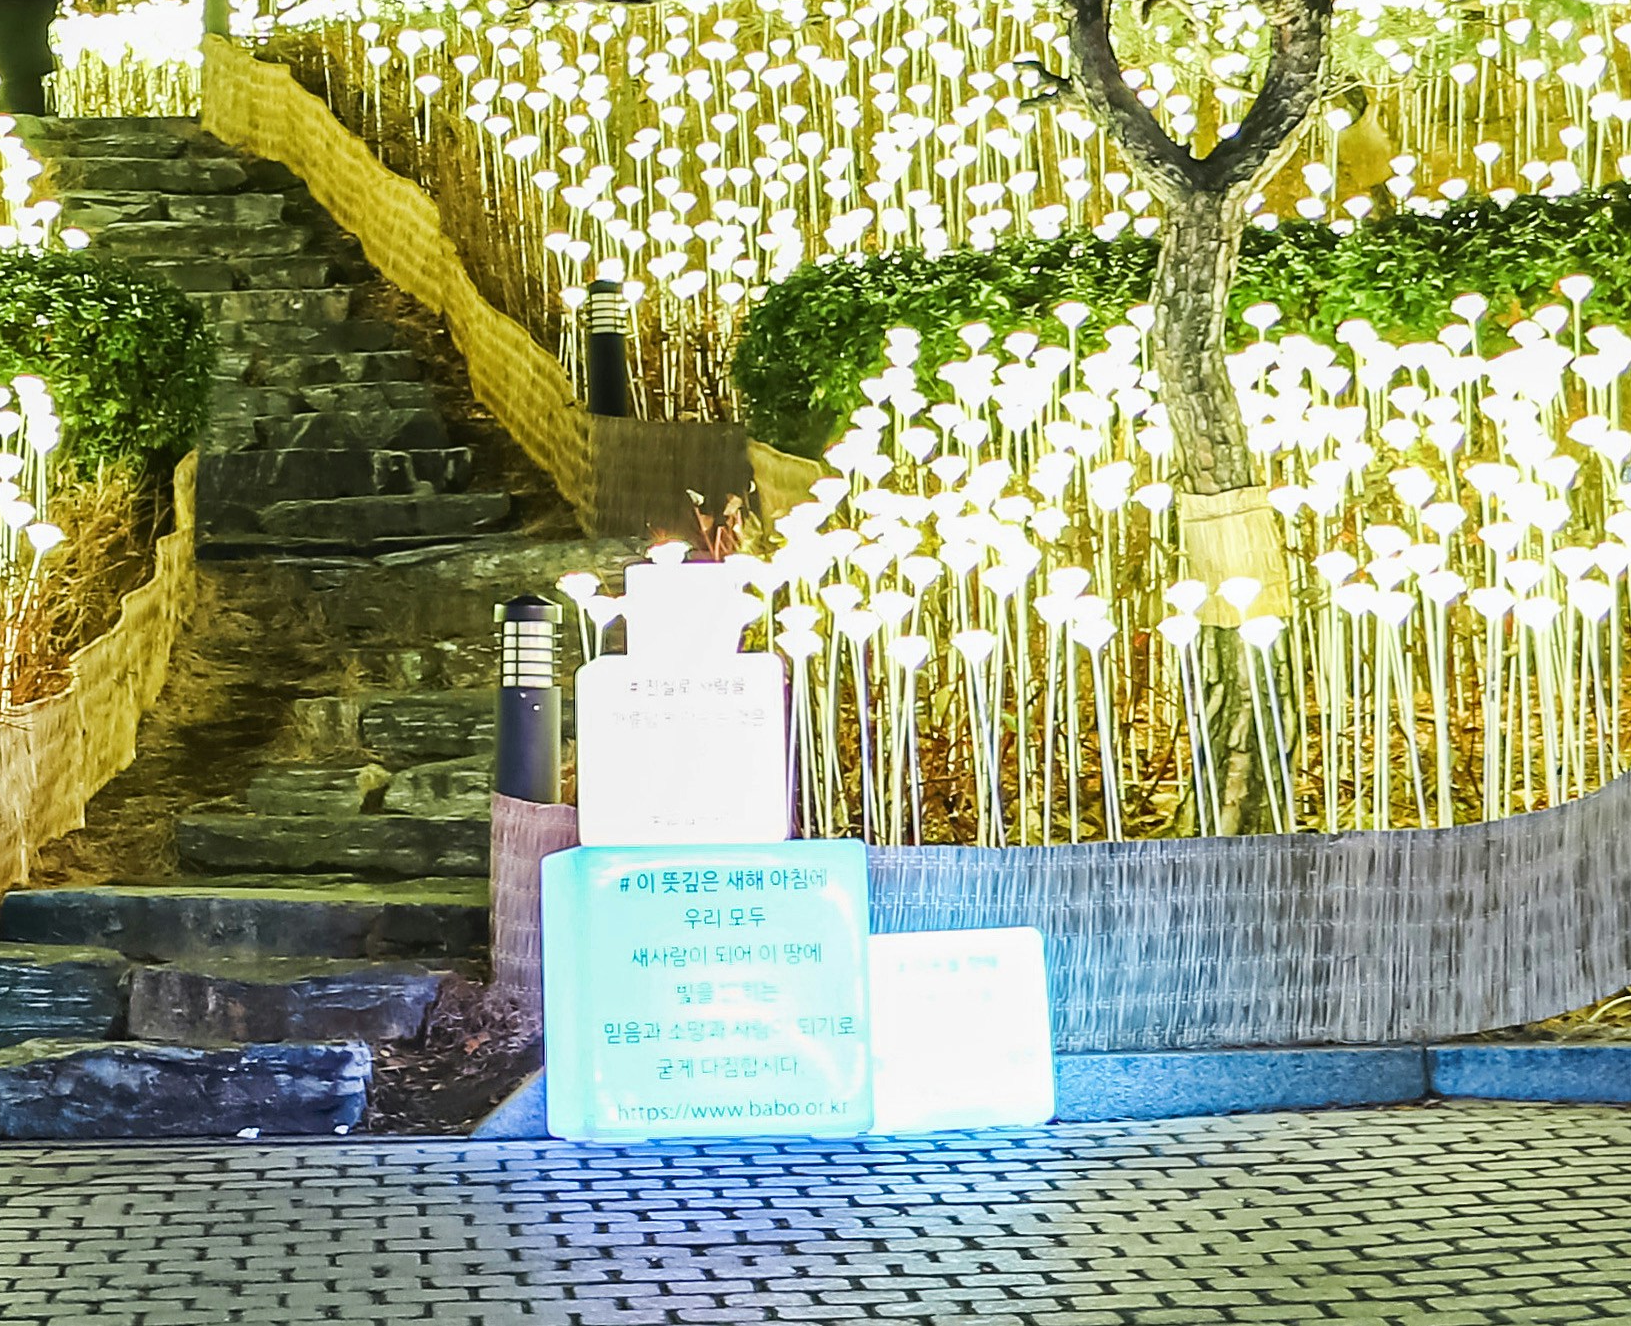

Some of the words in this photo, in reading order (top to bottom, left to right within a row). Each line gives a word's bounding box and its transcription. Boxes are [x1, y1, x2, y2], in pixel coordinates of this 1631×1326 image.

[619, 877, 631, 892] #
[636, 873, 655, 894] 이
[661, 870, 719, 893] 뜻깊은
[725, 869, 764, 891] 새해
[770, 868, 828, 890] 아침에
[684, 908, 721, 929] 우리
[728, 906, 766, 926] 모두
[631, 946, 706, 968] 새사람이
[715, 944, 752, 965] 되어
[759, 944, 777, 965] 이
[783, 942, 822, 965] 땅에
[604, 1021, 661, 1045] 믿음과
[656, 1057, 694, 1080] 굳게
